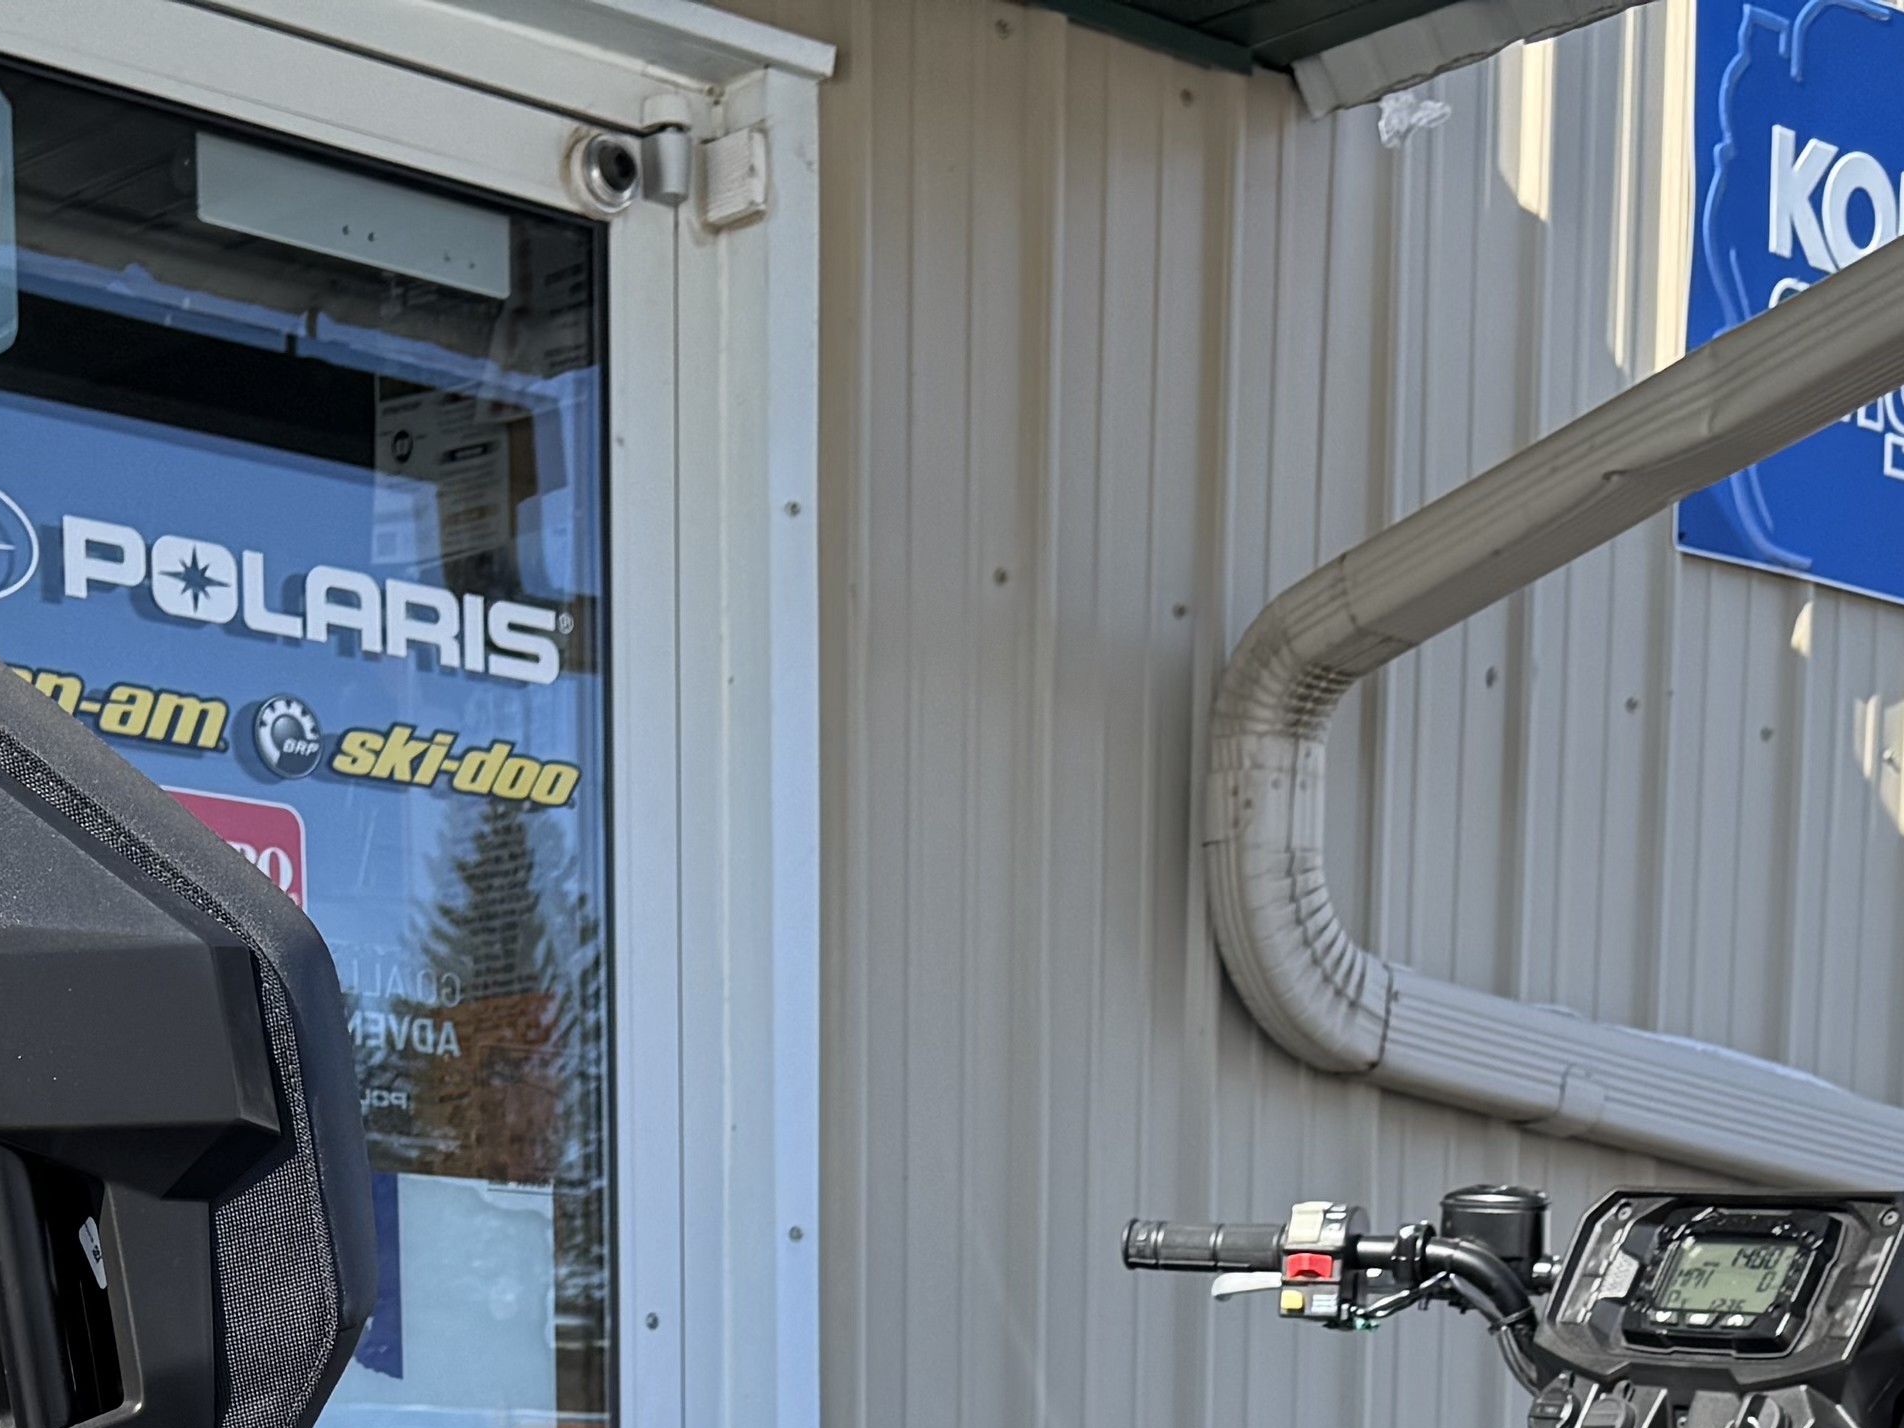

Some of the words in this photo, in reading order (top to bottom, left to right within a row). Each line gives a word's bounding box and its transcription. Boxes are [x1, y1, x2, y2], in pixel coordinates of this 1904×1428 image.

[61, 515, 562, 685] POLARIS
[10, 664, 226, 748] n-am
[282, 738, 320, 757] BRP
[333, 724, 582, 807] ski-doo
